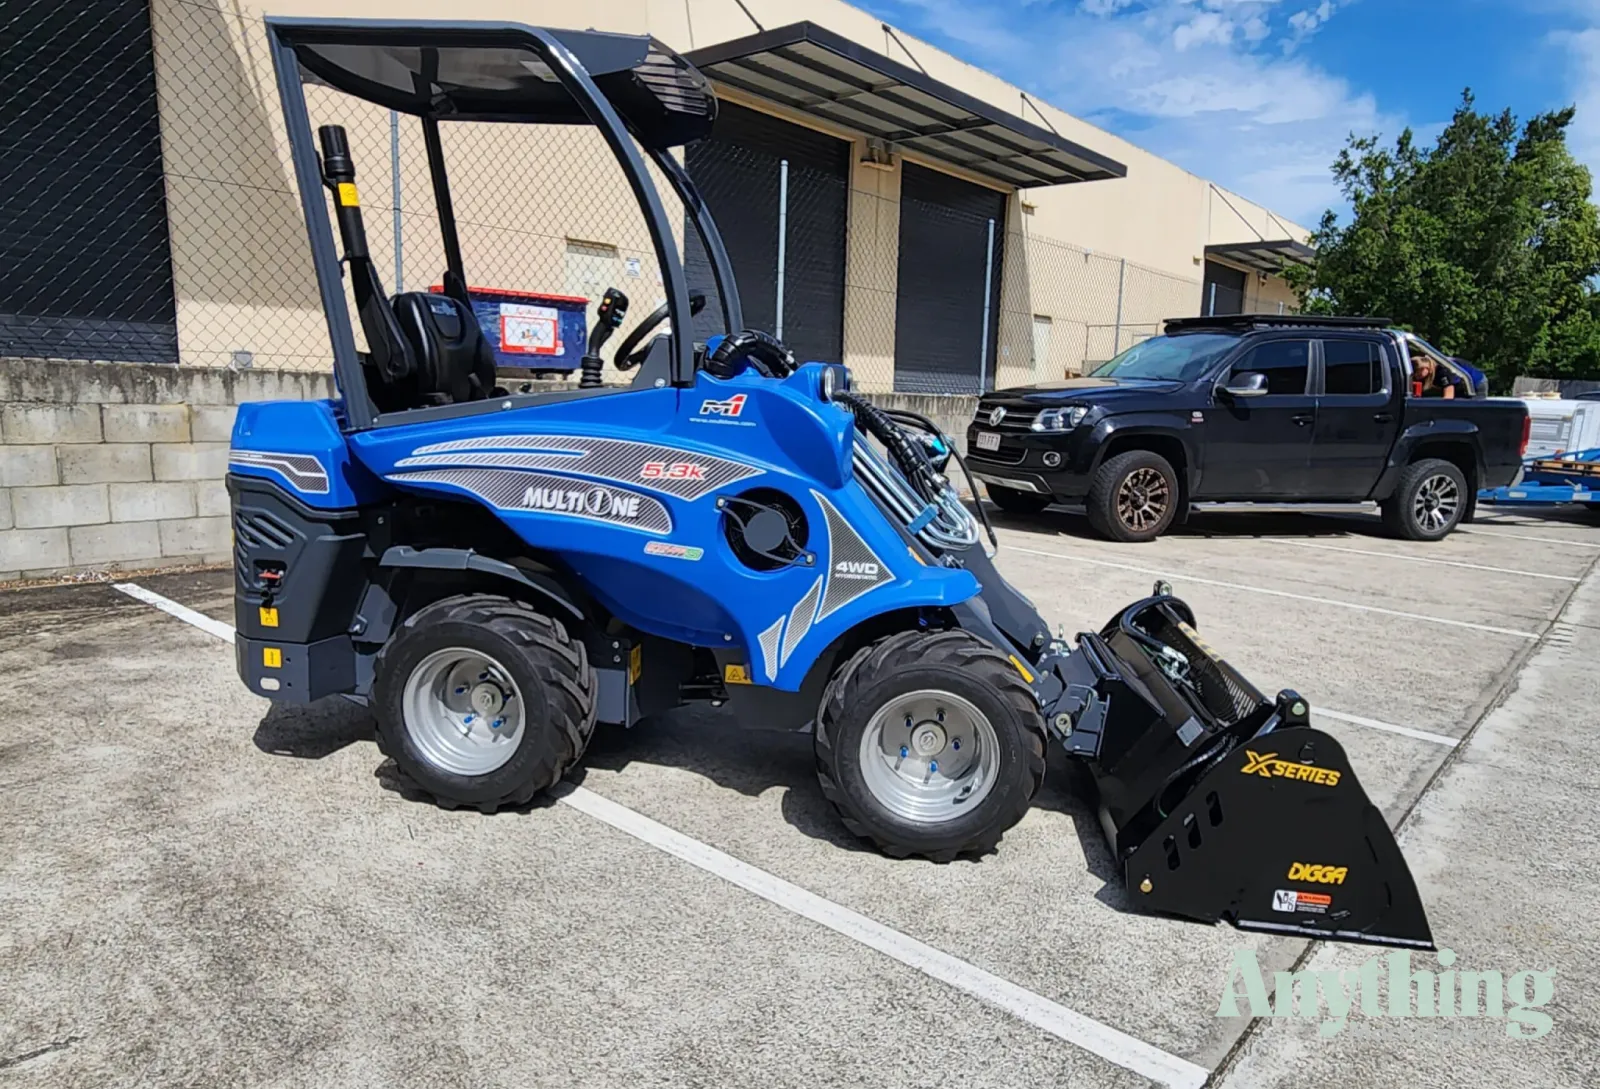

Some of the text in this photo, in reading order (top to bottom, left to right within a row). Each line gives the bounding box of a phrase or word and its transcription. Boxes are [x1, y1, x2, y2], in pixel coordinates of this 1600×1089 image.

[700, 394, 748, 416] M1
[836, 561, 878, 574] 4WD
[1288, 862, 1348, 884] DIGGA
